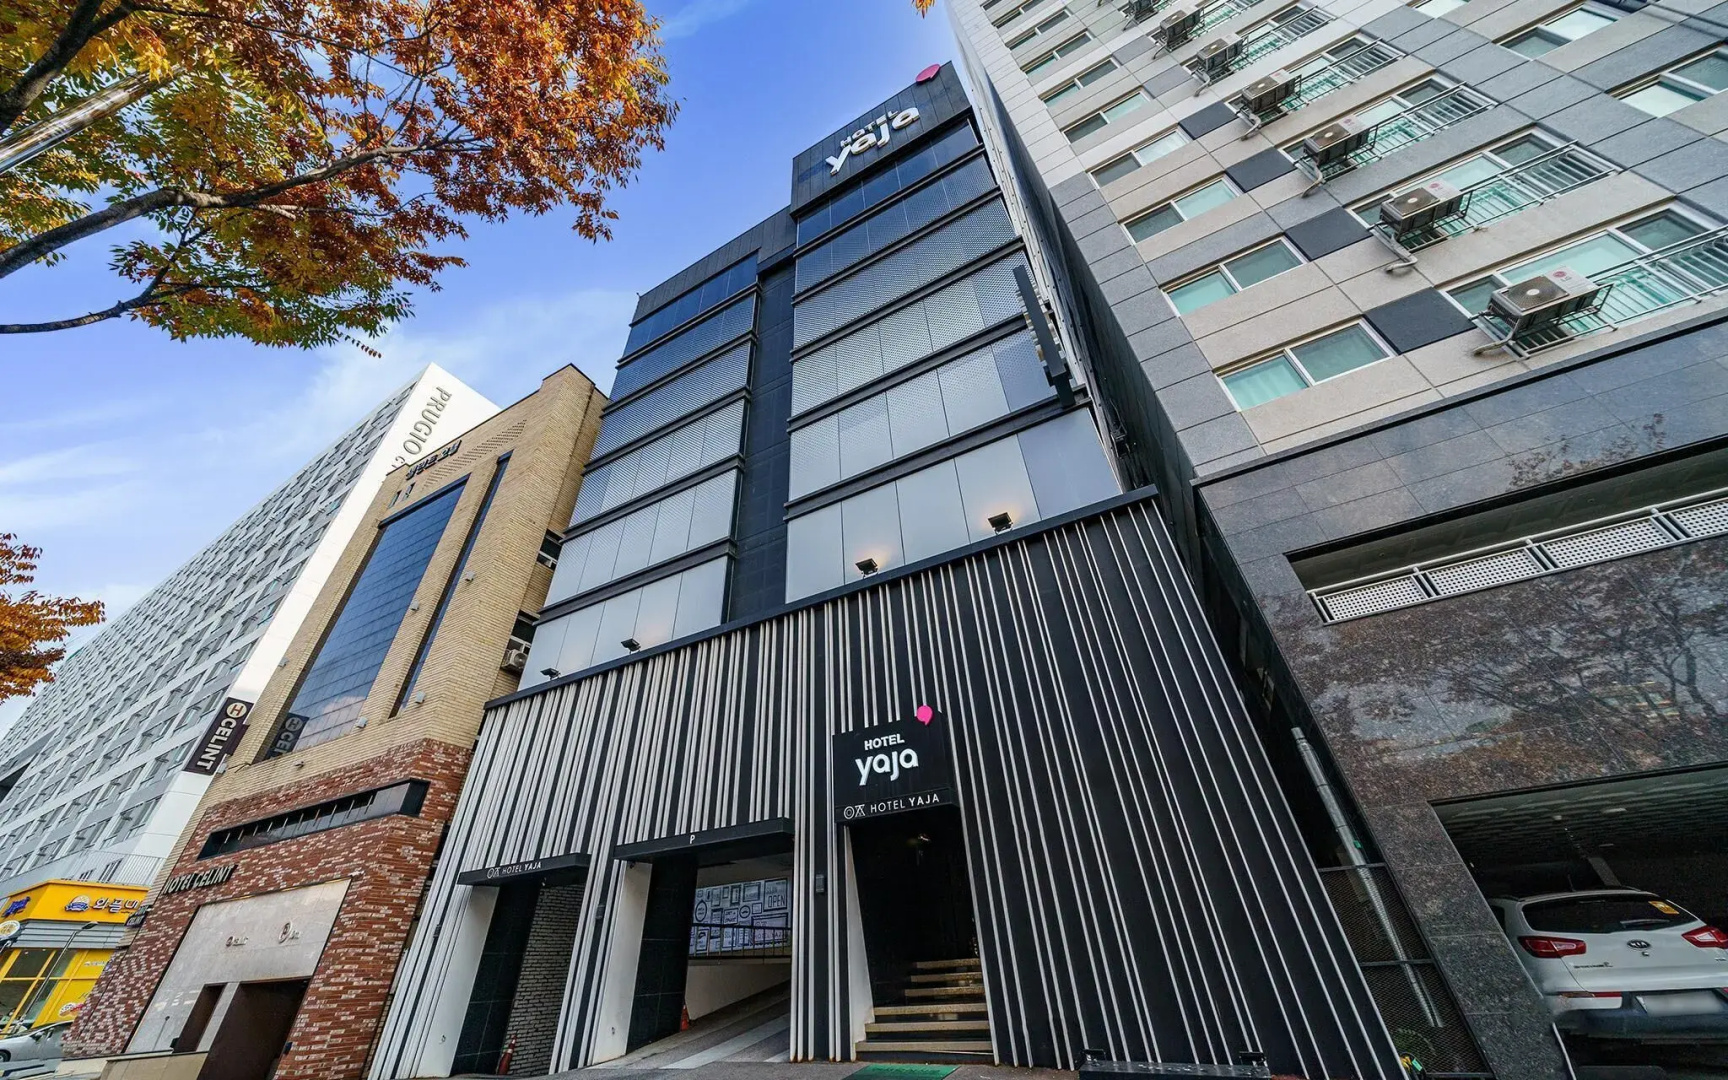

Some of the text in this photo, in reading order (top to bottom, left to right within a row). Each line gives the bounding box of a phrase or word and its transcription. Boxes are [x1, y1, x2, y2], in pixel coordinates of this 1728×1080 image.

[825, 107, 919, 176] yaja
[840, 110, 898, 148] HOTL
[403, 386, 452, 456] PRUGIO
[197, 718, 237, 770] CELINT
[864, 733, 905, 751] HOTEL
[855, 748, 919, 786] yaja
[870, 799, 906, 813] HOTEL
[908, 793, 940, 807] YAJA
[689, 834, 696, 844] P
[161, 864, 236, 895] HOTEL CELINT
[502, 866, 522, 875] HOTEL
[524, 861, 542, 871] YAJA
[93, 897, 139, 913] 와플대
